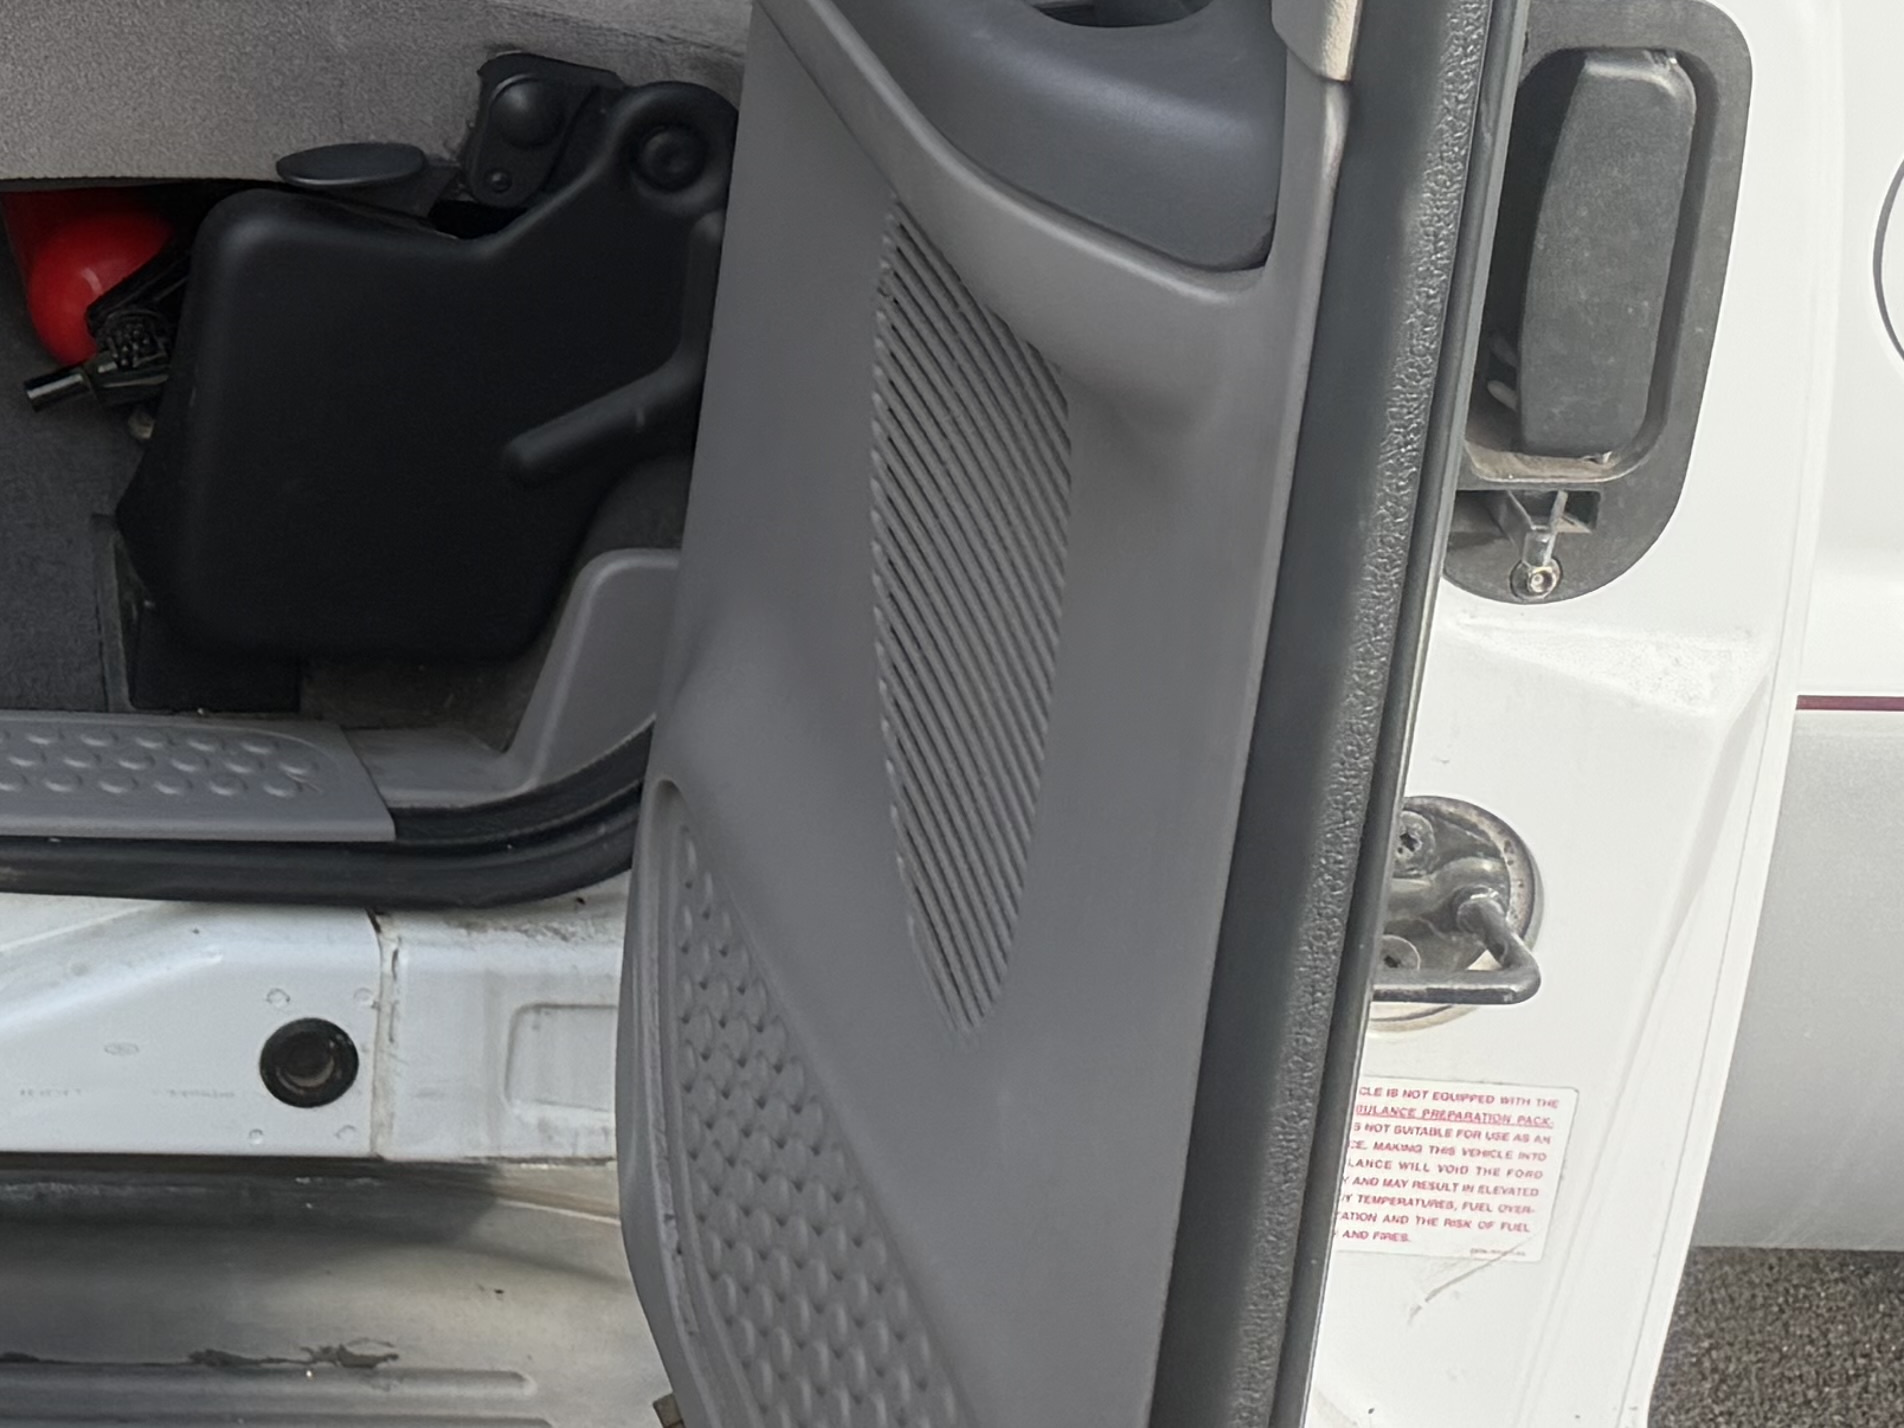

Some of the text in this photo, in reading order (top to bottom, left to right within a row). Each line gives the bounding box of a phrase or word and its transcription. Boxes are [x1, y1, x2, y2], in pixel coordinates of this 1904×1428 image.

[1403, 1090, 1429, 1099] NOT
[1432, 1091, 1495, 1105] EQUIPPED
[1500, 1096, 1530, 1106] WITH
[1536, 1098, 1559, 1109] THE
[1422, 1109, 1512, 1124] PREPARATION
[1364, 1122, 1391, 1133] NOT
[1394, 1125, 1453, 1138] SUITABLE
[1456, 1129, 1482, 1140] FOR
[1485, 1131, 1510, 1141] USE
[1512, 1133, 1530, 1142] AS
[1533, 1135, 1551, 1145] AN
[1373, 1141, 1423, 1153] MAKING
[1429, 1145, 1456, 1156] THIS
[1461, 1147, 1513, 1160] VEHICLE
[1517, 1151, 1547, 1162] INTO
[1398, 1161, 1430, 1172] WILL
[1437, 1164, 1469, 1175] VOID
[1475, 1166, 1501, 1177] THE
[1506, 1169, 1544, 1180] FORD
[1352, 1176, 1379, 1186] AND
[1382, 1178, 1409, 1189] MAY
[1411, 1180, 1459, 1192] RESULT
[1462, 1184, 1474, 1193] IN
[1477, 1184, 1539, 1197] ELEVATED
[1358, 1194, 1458, 1211] TEMPERATURES,
[1462, 1201, 1493, 1212] FUEL
[1382, 1214, 1409, 1225] AND
[1415, 1215, 1439, 1226] THE
[1443, 1218, 1472, 1229] RISK
[1477, 1220, 1495, 1230] OF
[1500, 1221, 1531, 1233] FUEL
[1342, 1230, 1369, 1240] AND
